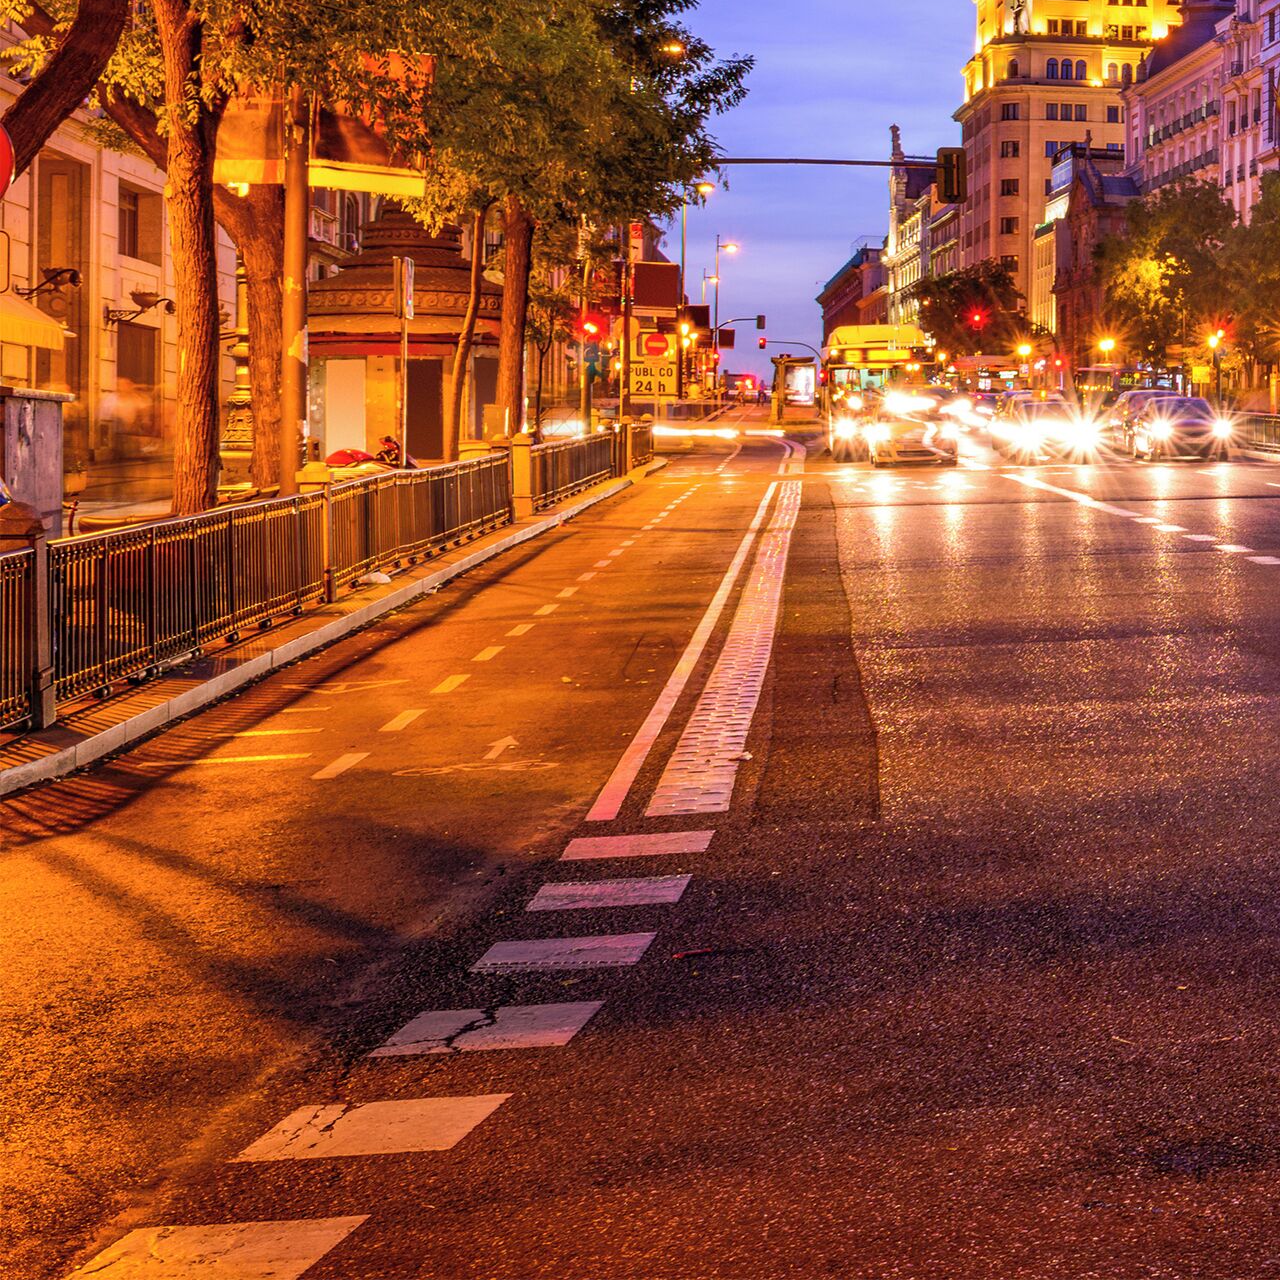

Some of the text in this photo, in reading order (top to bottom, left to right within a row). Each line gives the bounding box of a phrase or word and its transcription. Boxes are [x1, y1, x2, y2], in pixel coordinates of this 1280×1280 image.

[629, 367, 673, 377] PUBLCO
[635, 380, 666, 392] 24 h
